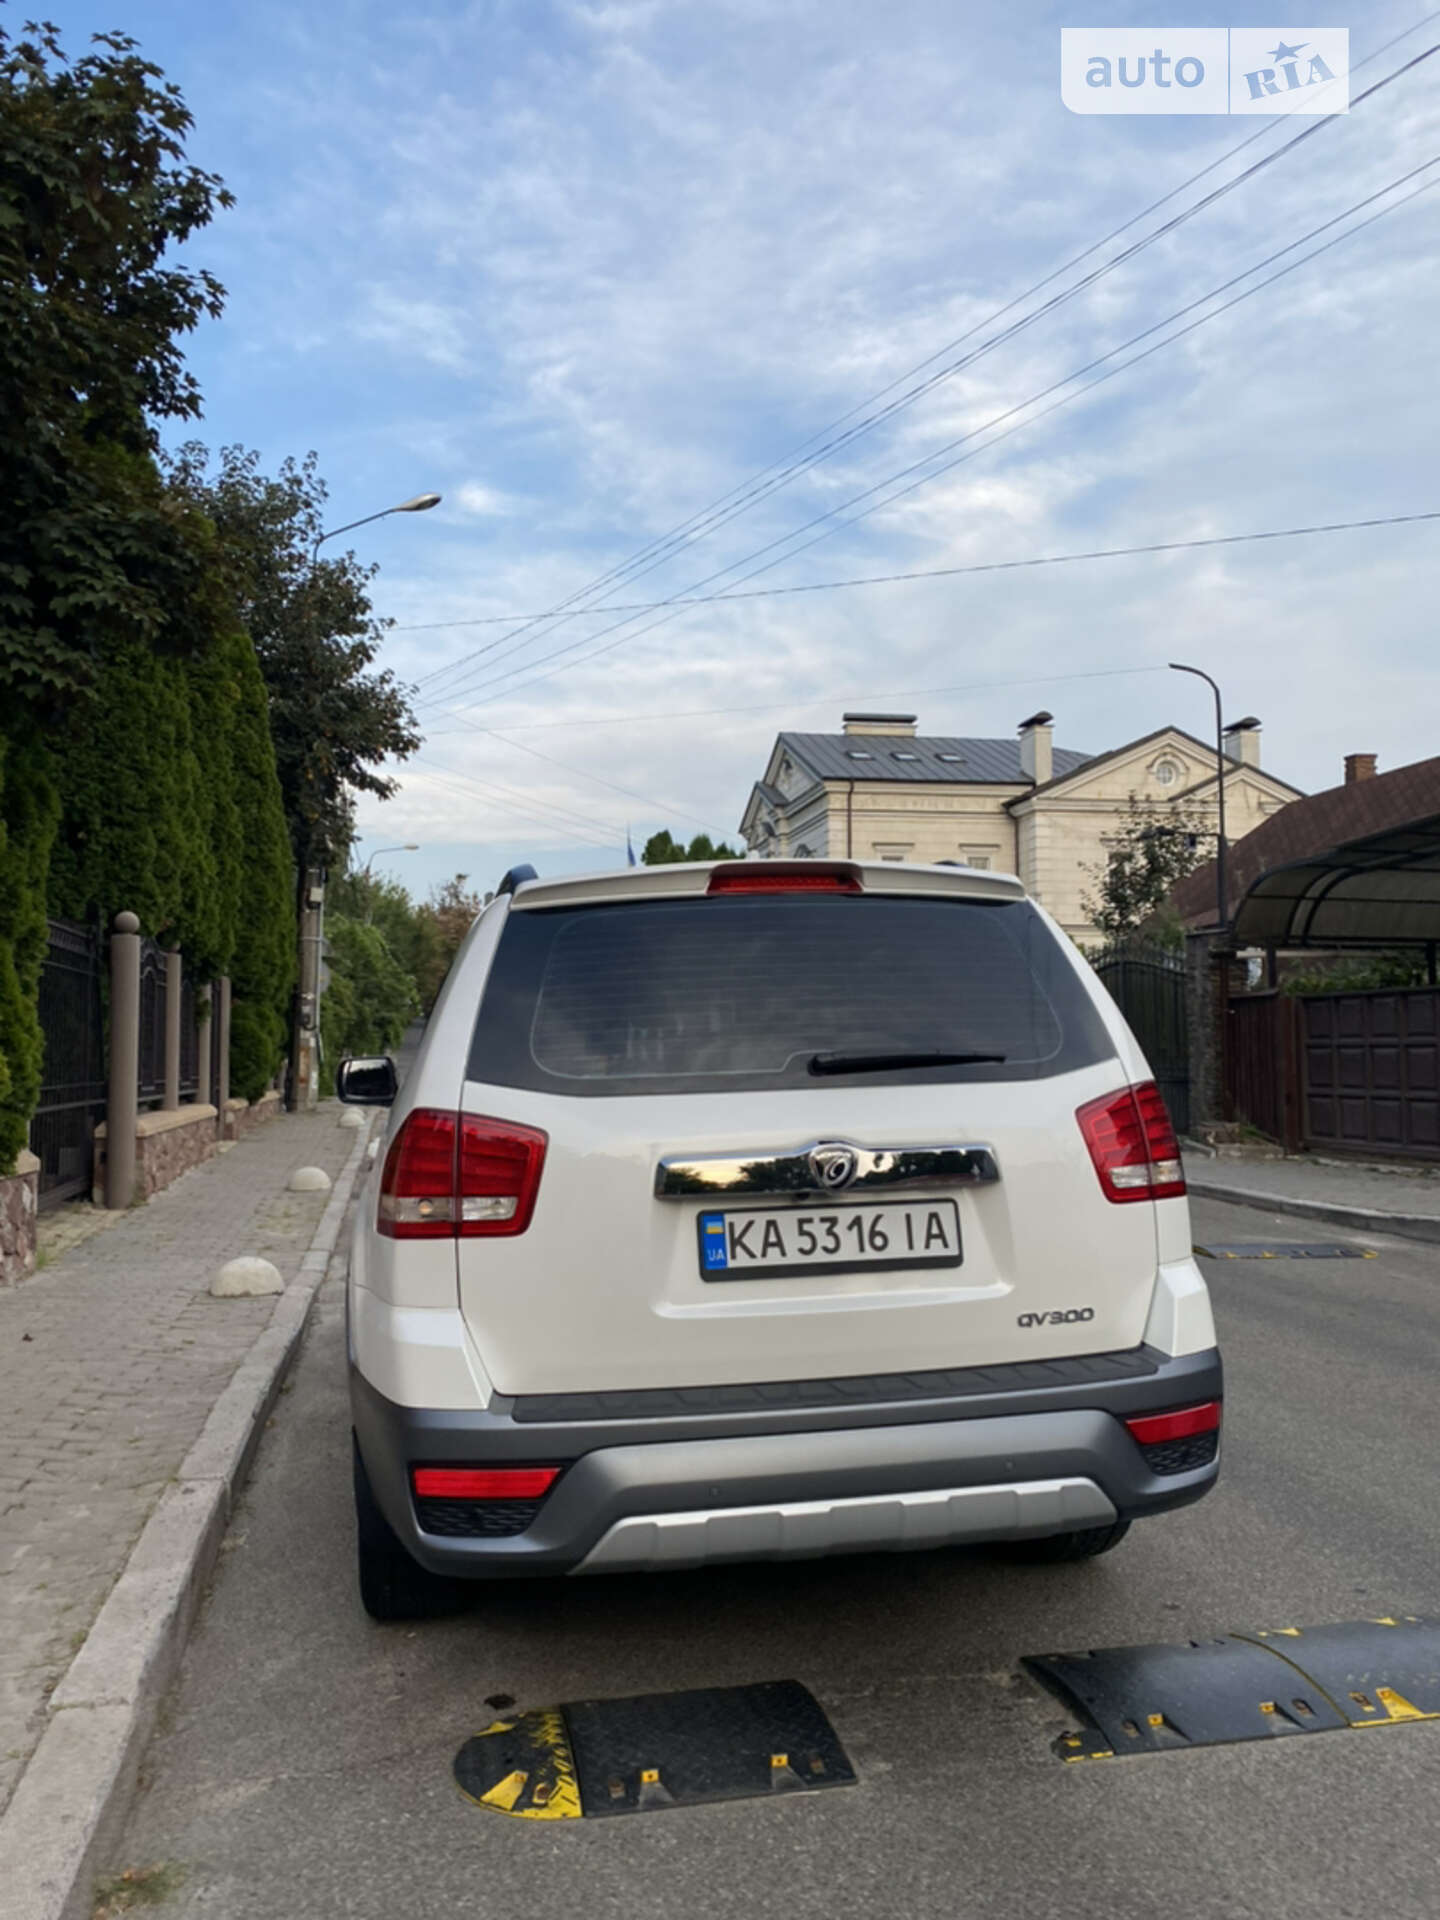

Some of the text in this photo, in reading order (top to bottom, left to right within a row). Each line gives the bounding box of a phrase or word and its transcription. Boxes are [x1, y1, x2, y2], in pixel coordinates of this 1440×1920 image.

[729, 1212, 949, 1261] KA 5316 IA
[707, 1248, 725, 1262] UA
[1017, 1307, 1094, 1330] QV300
